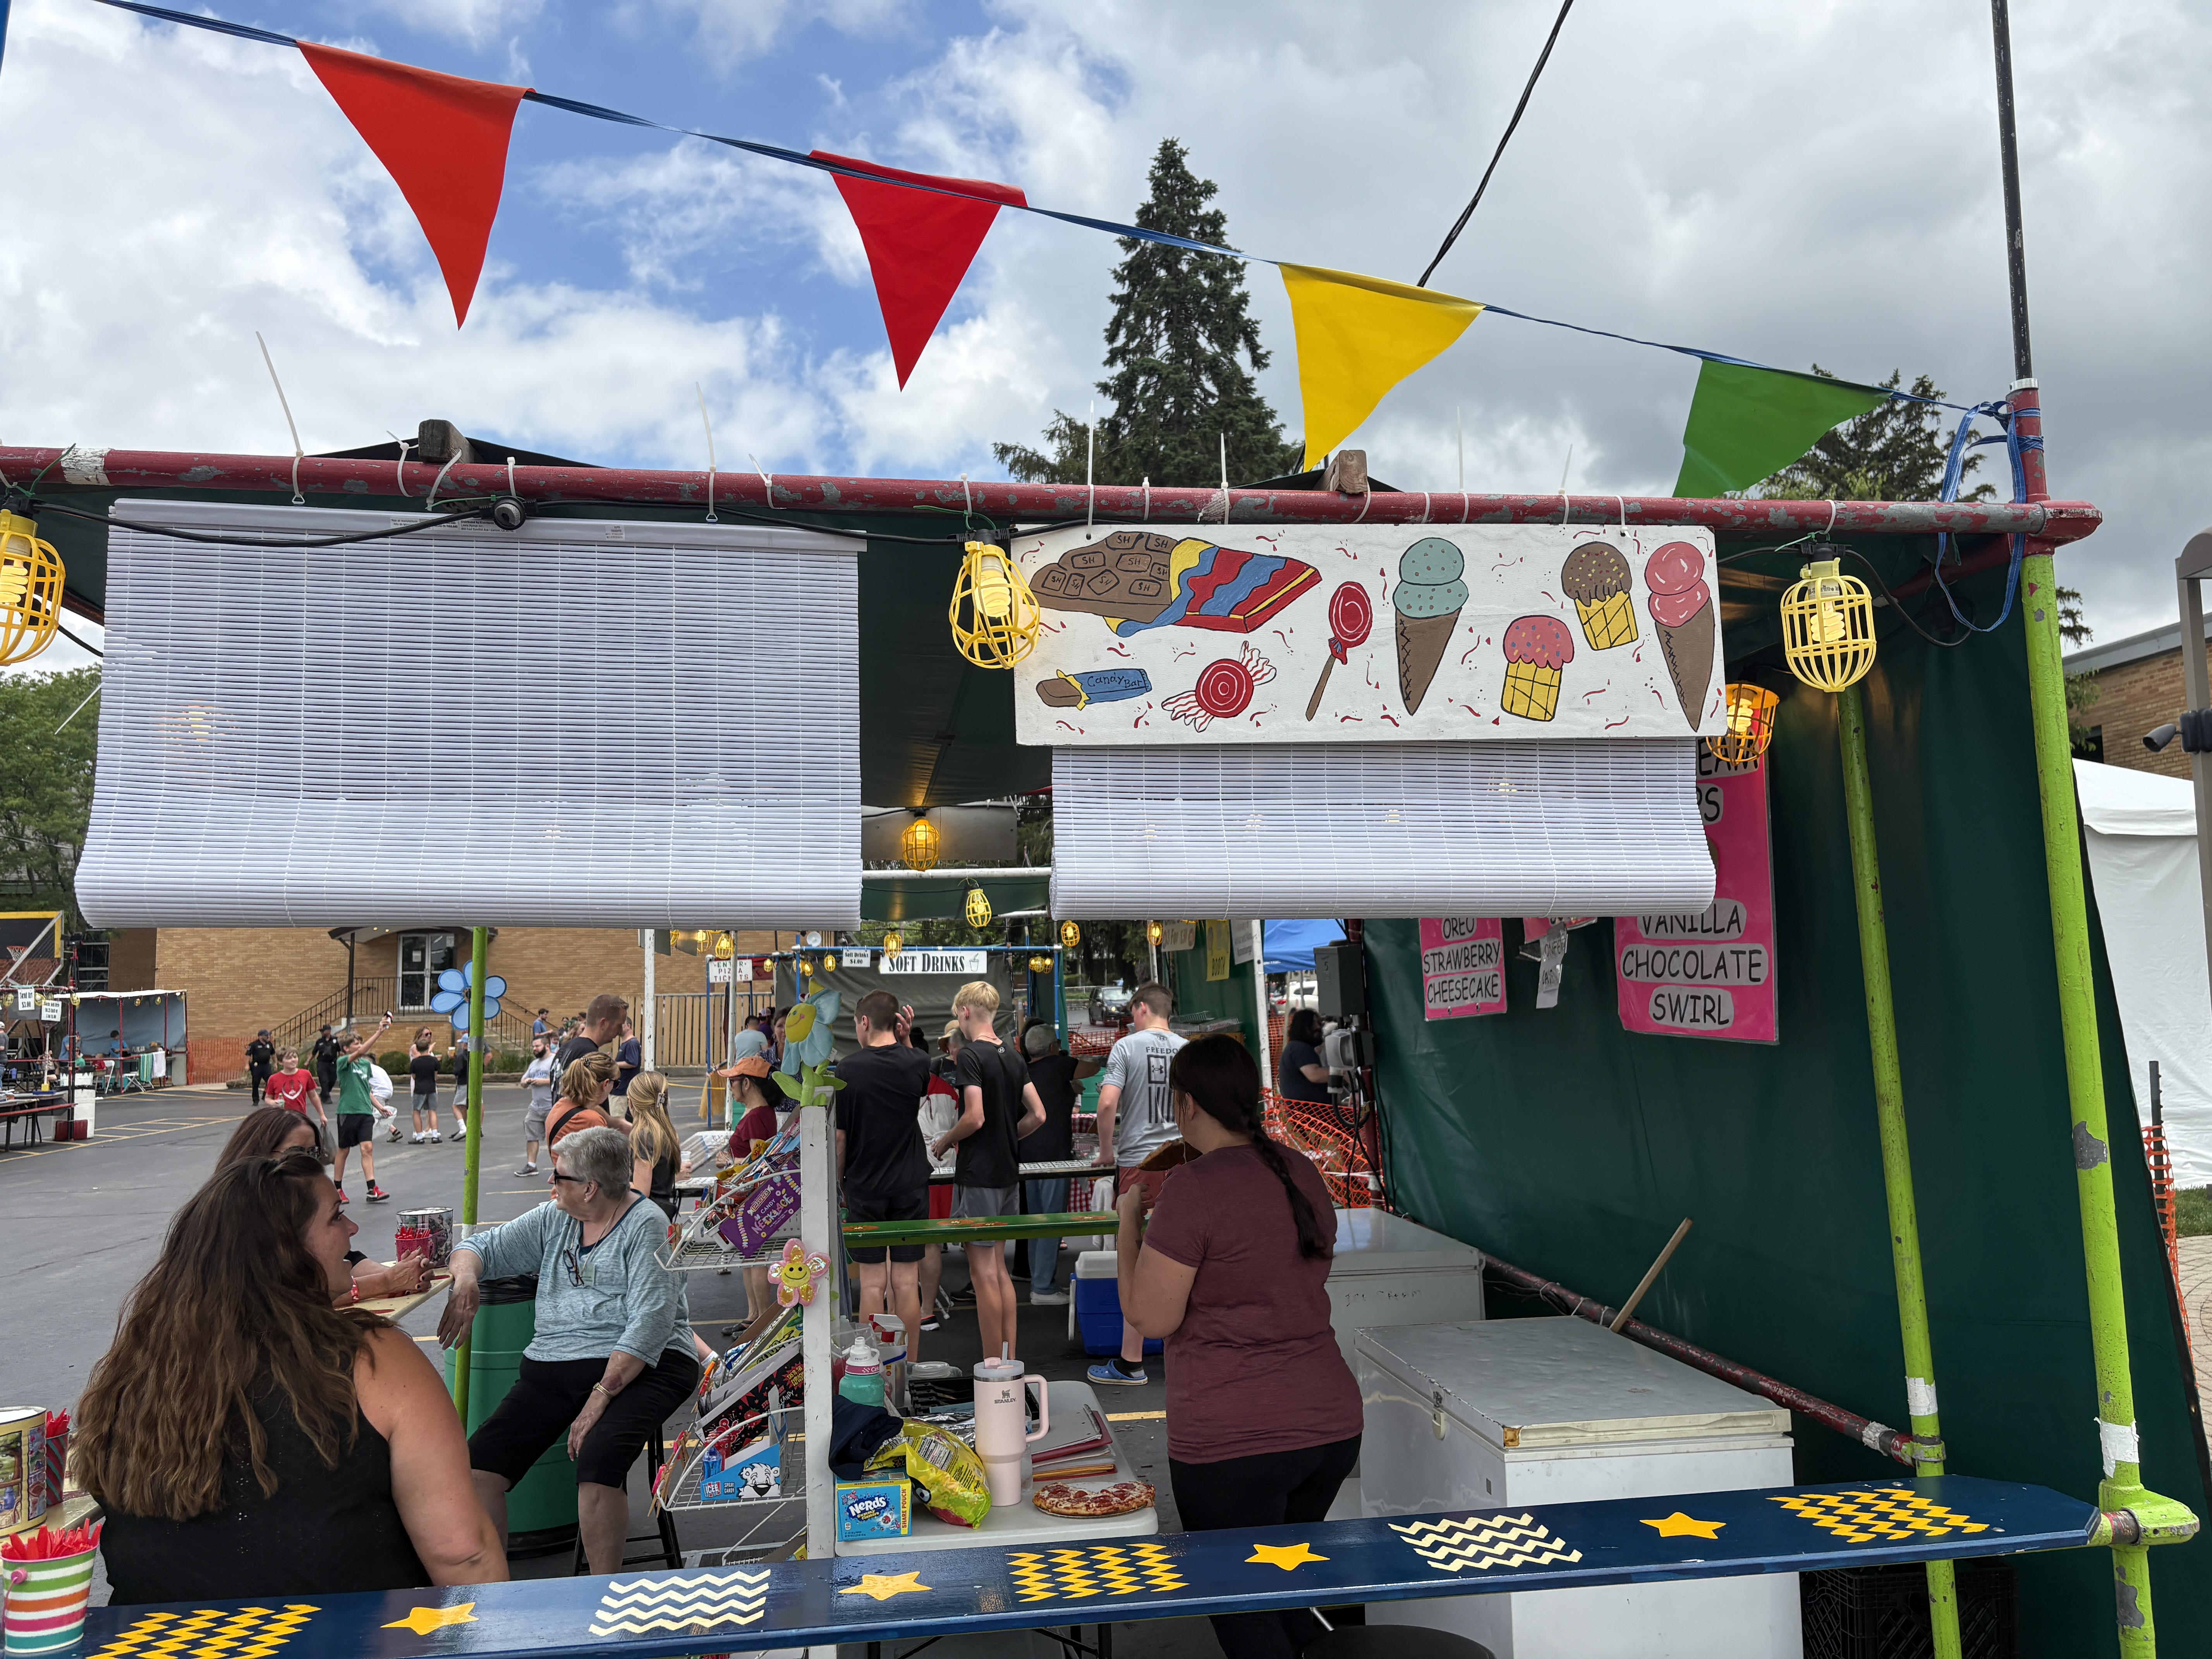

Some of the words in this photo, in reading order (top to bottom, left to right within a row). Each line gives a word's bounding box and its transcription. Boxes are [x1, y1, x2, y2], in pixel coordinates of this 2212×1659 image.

[1117, 535, 1130, 543] SH
[1154, 538, 1168, 548] SH
[1128, 557, 1141, 565] SH
[1071, 579, 1080, 590] SH
[1099, 576, 1113, 586] SH
[1138, 583, 1151, 591] SH
[1087, 672, 1125, 687] Candy
[1124, 679, 1142, 688] Bar
[1642, 903, 1741, 935] VANILLA
[922, 953, 965, 972] DRINKS
[1424, 941, 1500, 974] STRAWBERRY
[1622, 949, 1762, 982] CHOCOLATE
[1427, 973, 1499, 1003] CHEESECAKE
[1652, 993, 1729, 1025] SWIRL
[751, 1193, 793, 1234] NECKLACE
[760, 1198, 775, 1214] CANDY
[780, 1390, 794, 1403] CANDY
[706, 1484, 720, 1494] ICEE
